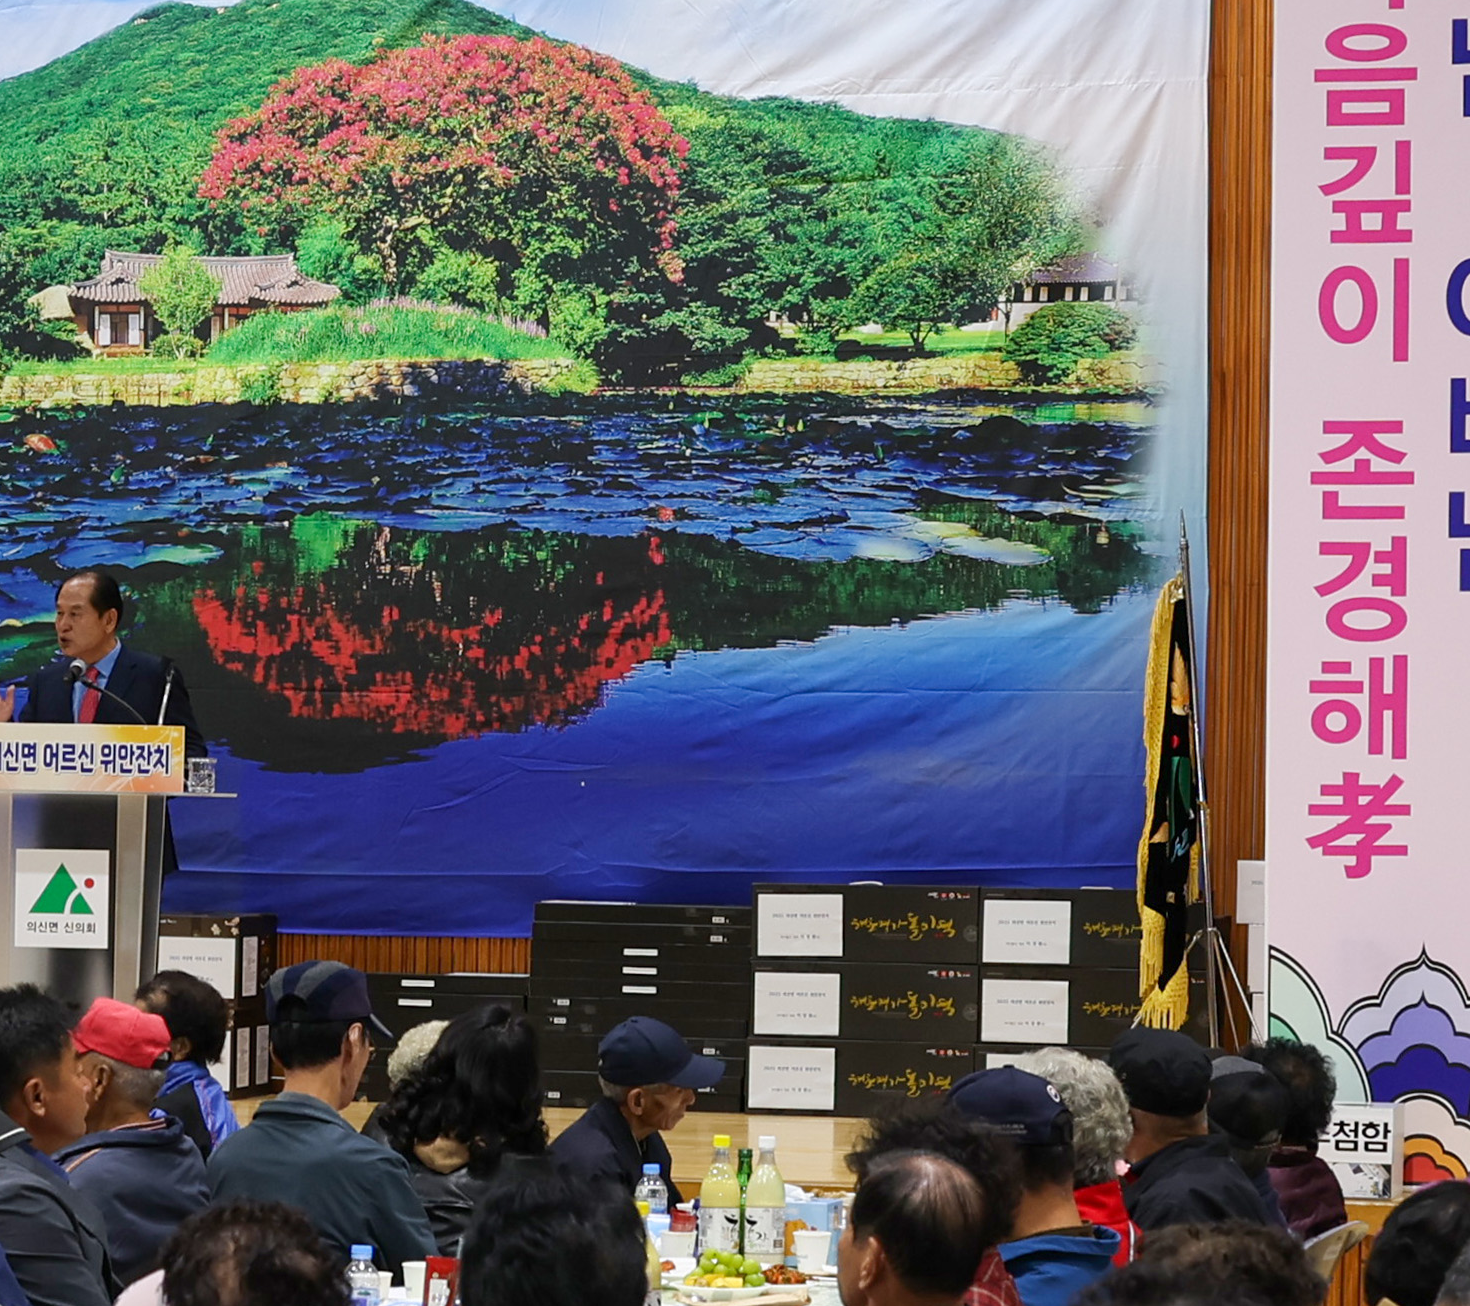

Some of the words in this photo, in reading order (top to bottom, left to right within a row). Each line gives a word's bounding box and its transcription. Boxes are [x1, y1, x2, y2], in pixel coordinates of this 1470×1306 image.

[42, 742, 96, 774] 어르신
[99, 743, 171, 776] 위안잔치
[26, 920, 59, 934] 의신면
[63, 920, 97, 935] 신의회
